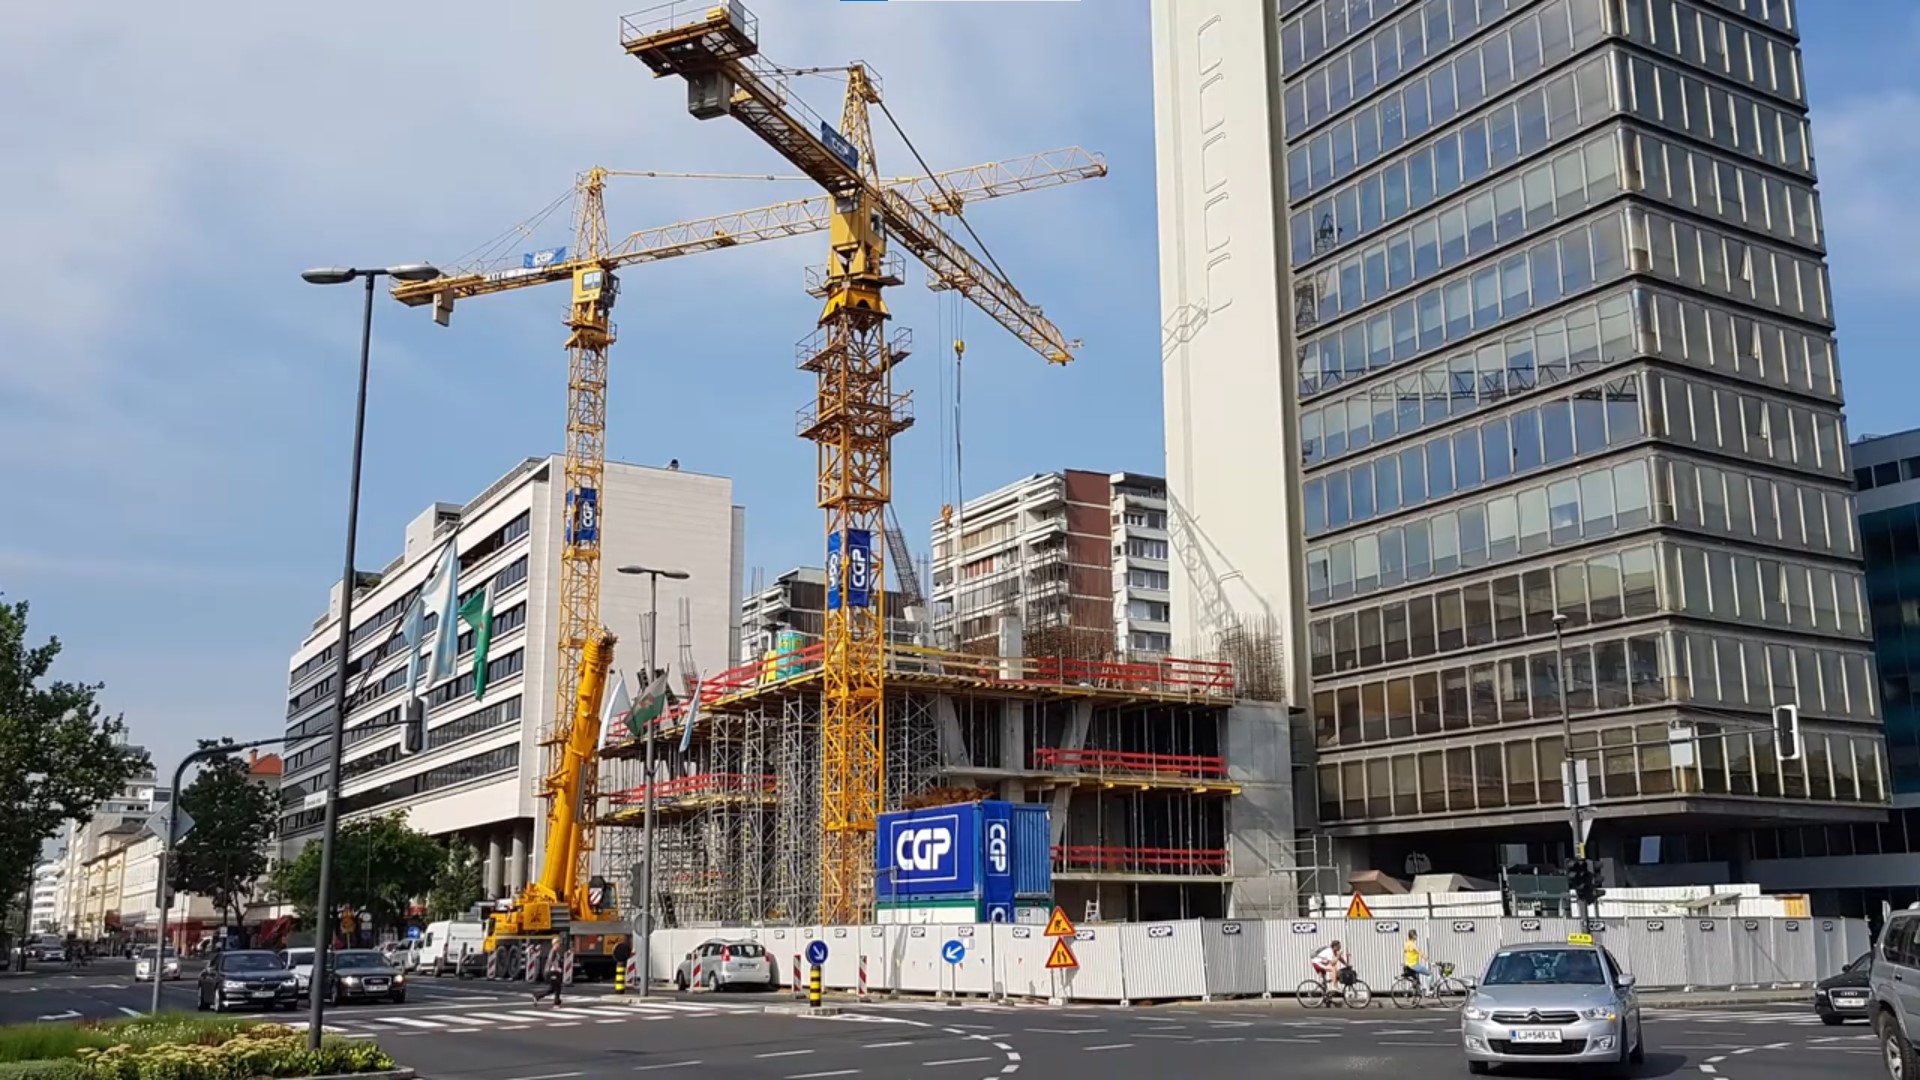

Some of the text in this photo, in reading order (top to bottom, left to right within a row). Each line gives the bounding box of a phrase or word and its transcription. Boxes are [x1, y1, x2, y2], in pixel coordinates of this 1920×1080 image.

[583, 501, 593, 527] CGP
[852, 548, 866, 587] CGP
[896, 827, 951, 871] CGP
[989, 823, 1006, 872] CGP
[1223, 925, 1239, 933] CGP
[1293, 923, 1315, 932] CGP
[1377, 922, 1399, 931] CGP
[1454, 922, 1474, 931] CGP
[1522, 920, 1540, 930] CGP
[1150, 927, 1171, 936] CGP
[1518, 1031, 1528, 1040] LJ
